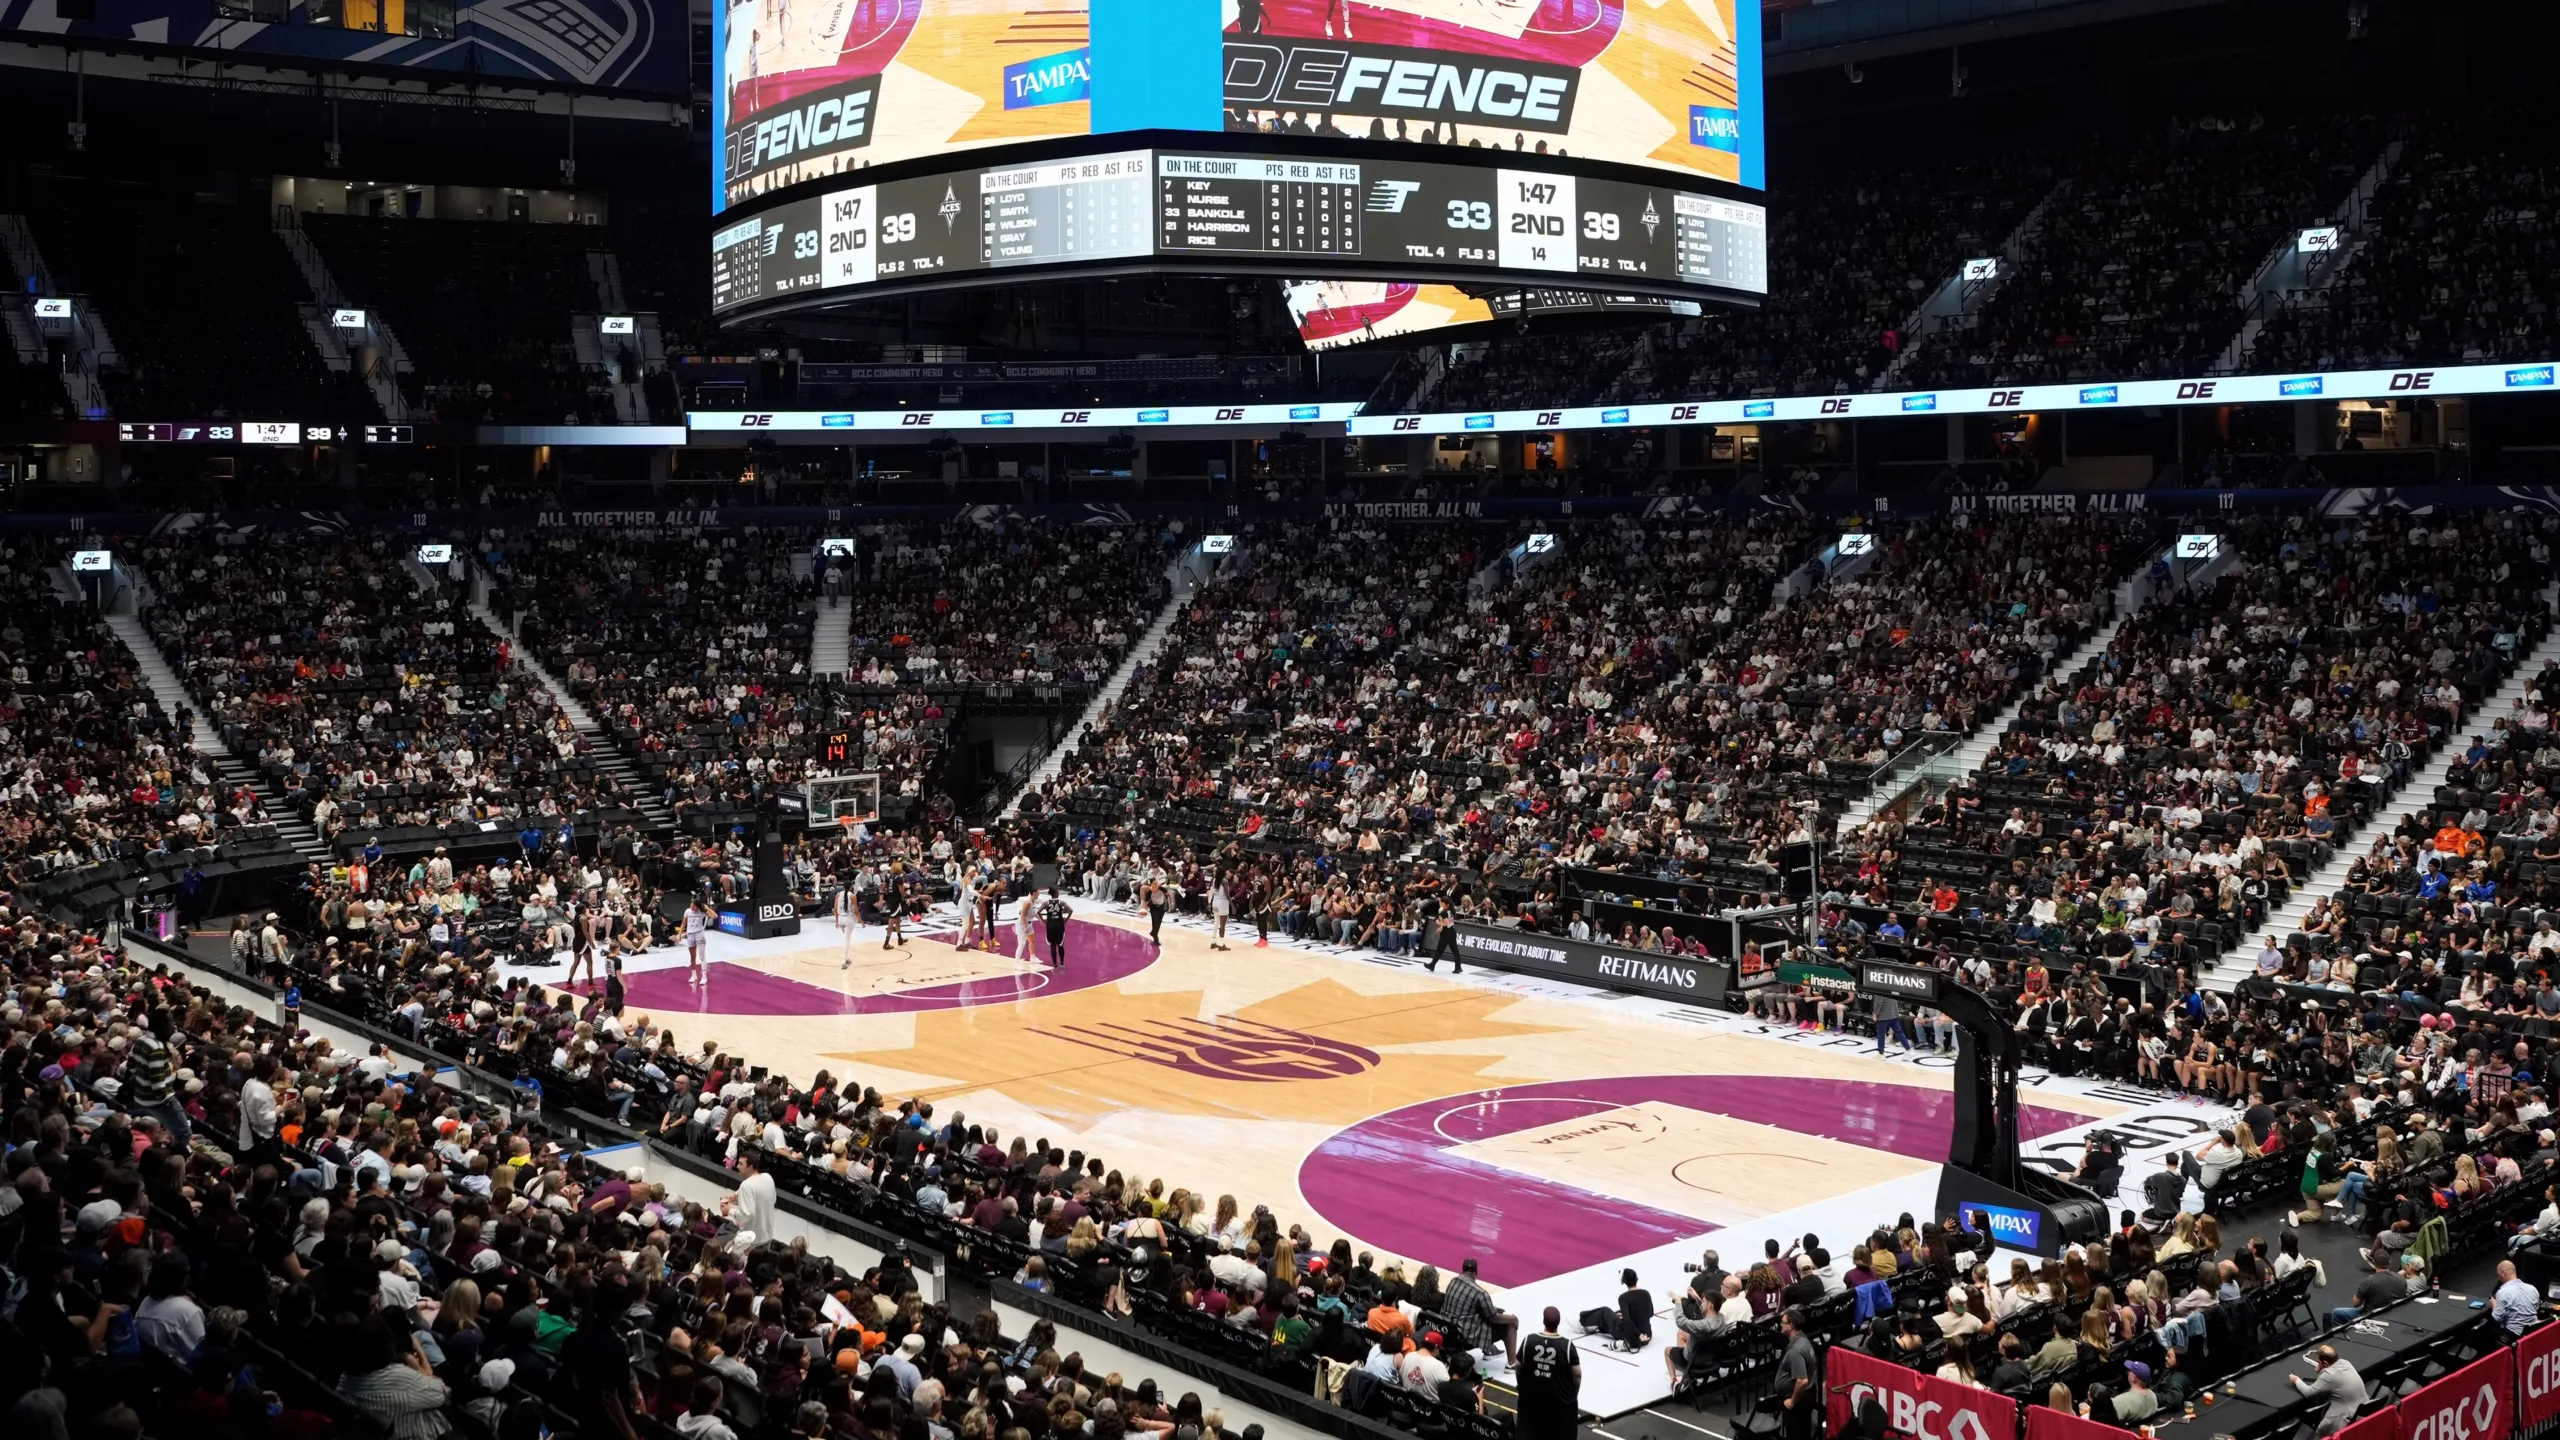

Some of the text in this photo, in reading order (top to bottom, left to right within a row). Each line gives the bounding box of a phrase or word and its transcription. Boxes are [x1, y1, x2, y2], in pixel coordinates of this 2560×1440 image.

[1222, 42, 1568, 122] DEFENCE
[1694, 116, 1738, 138] TAMPA
[725, 90, 871, 183] DEFENCE
[1061, 160, 1142, 180] PTS REB AST FLS
[1167, 160, 1237, 174] ON THE COURT
[1266, 164, 1356, 180] PTS REB AST FLS
[985, 171, 1038, 189] ON THE COURT
[1165, 180, 1279, 193] 7 KEY 2
[1518, 181, 1556, 204] 1:47
[1165, 194, 1279, 207] 11 NURSE 3
[835, 198, 861, 222] 1:47
[939, 202, 960, 213] ACES
[1000, 206, 1028, 216] SMITH
[1165, 208, 1279, 220] 33 BANKOLE 0
[1447, 200, 1491, 230] 33
[1641, 214, 1660, 224] ACES
[882, 213, 916, 244] 39
[984, 218, 1036, 232] 22 WILSON
[1165, 222, 1279, 234] 21 HARRISON 4
[1511, 212, 1564, 236] 2ND
[1583, 211, 1620, 241] 39
[794, 230, 818, 259] 33
[830, 228, 866, 253] 2ND
[1000, 233, 1026, 243] GRAY
[1165, 235, 1279, 247] 1 RICE 5
[1000, 245, 1032, 256] YOUNG
[1406, 245, 1495, 260] TOL 4 FLS 3
[1531, 246, 1546, 261] 14
[842, 263, 852, 276] 14
[878, 256, 944, 274] FLS 2 TOL 4
[1579, 257, 1647, 272] FLS 2 TOL 4
[799, 275, 813, 286] FLS
[815, 273, 820, 283] 3
[44, 304, 60, 312] DE
[874, 368, 920, 378] COMMUNITY
[1028, 366, 1074, 376] COMMUNITY
[2508, 370, 2552, 383] TAMPAX
[2281, 380, 2320, 392] TAMPAX
[2389, 372, 2434, 390] DE
[2081, 390, 2115, 401] TAMPAX
[2176, 382, 2216, 399] DE
[1904, 397, 1934, 408] TAMPAX
[1988, 391, 2024, 406] DE
[1291, 408, 1318, 417] TAMPAX
[1746, 404, 1772, 414] TAMPAX
[1821, 399, 1852, 413] DE
[902, 413, 934, 425] DE
[983, 413, 1012, 422] TAMPAX
[1061, 412, 1091, 423] DE
[1138, 412, 1167, 420] TAMPAX
[1215, 409, 1245, 420] DE
[1537, 412, 1562, 425] DE
[1603, 410, 1627, 420] TAMPAX
[1671, 406, 1699, 420] DE
[741, 415, 773, 426] DE
[823, 416, 853, 425] TAMPAX
[1393, 418, 1421, 430] DE
[1466, 417, 1493, 426] TAMPAX
[209, 427, 233, 439] 33
[256, 424, 286, 435] 1:47
[307, 427, 331, 440] 39
[1561, 501, 1572, 514] 115
[1875, 497, 1888, 511] 116
[2124, 494, 2148, 512] IN.
[2218, 494, 2234, 509] 117
[828, 509, 841, 521] 113
[1227, 505, 1239, 517] 114
[1436, 503, 1463, 517] ALL
[1465, 503, 1483, 517] IN.
[71, 517, 85, 530] 111
[413, 513, 427, 526] 112
[538, 512, 567, 527] ALL
[665, 511, 696, 526] ALL
[828, 745, 844, 760] 14
[763, 903, 794, 918] BDO
[1048, 904, 1060, 912] 24
[1464, 938, 1485, 952] WE'VE
[1485, 940, 1513, 954] EVOLVED.
[1514, 944, 1527, 956] IT'S
[1528, 946, 1548, 959] ABOUT
[1549, 950, 1567, 964] TIME.
[1598, 955, 1696, 988] REITMANS
[1810, 973, 1855, 991] instacart
[1870, 971, 1926, 990] REITMANS
[1964, 1208, 2032, 1235] TMPAX
[1533, 1344, 1556, 1362] 22
